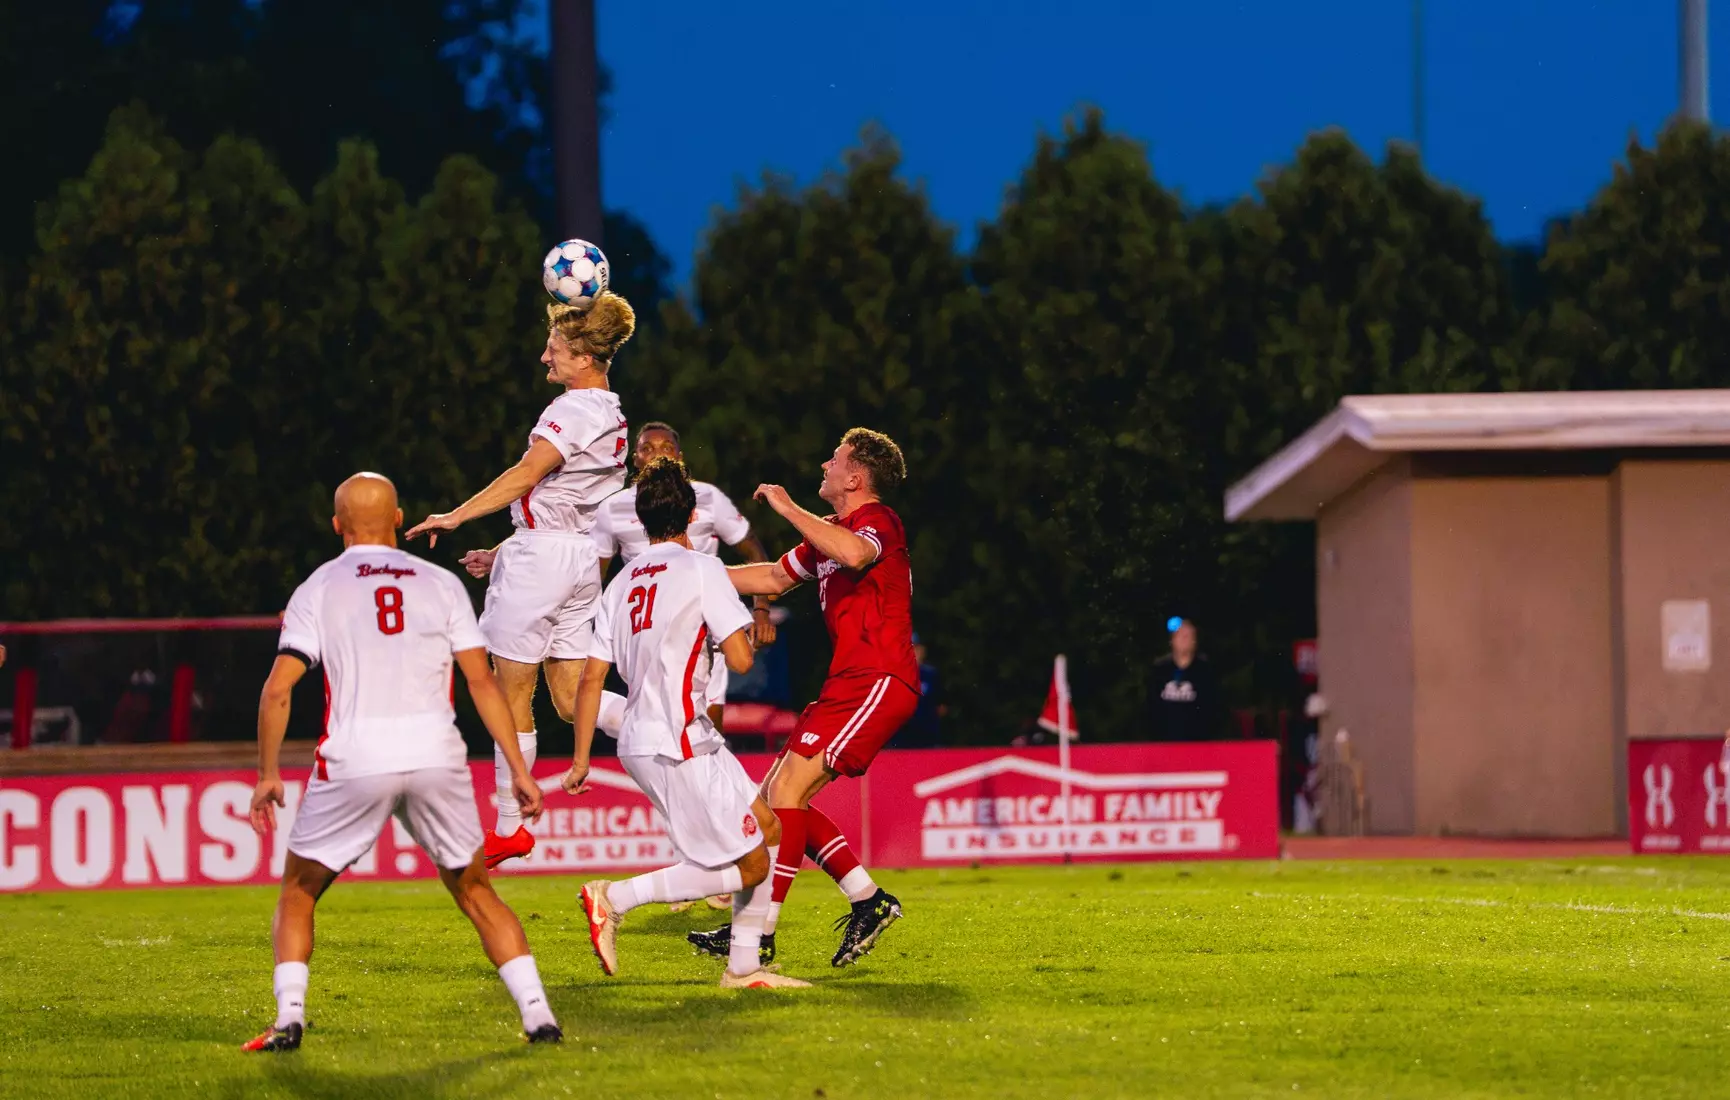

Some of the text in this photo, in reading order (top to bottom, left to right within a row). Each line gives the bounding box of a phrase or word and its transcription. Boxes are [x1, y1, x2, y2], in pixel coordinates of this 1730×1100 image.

[374, 586, 405, 635] 8
[627, 583, 658, 636] 21
[527, 805, 669, 838] MERICAN
[922, 790, 1223, 826] AMERICAN FAMILY
[946, 827, 1198, 851] INSURANCE
